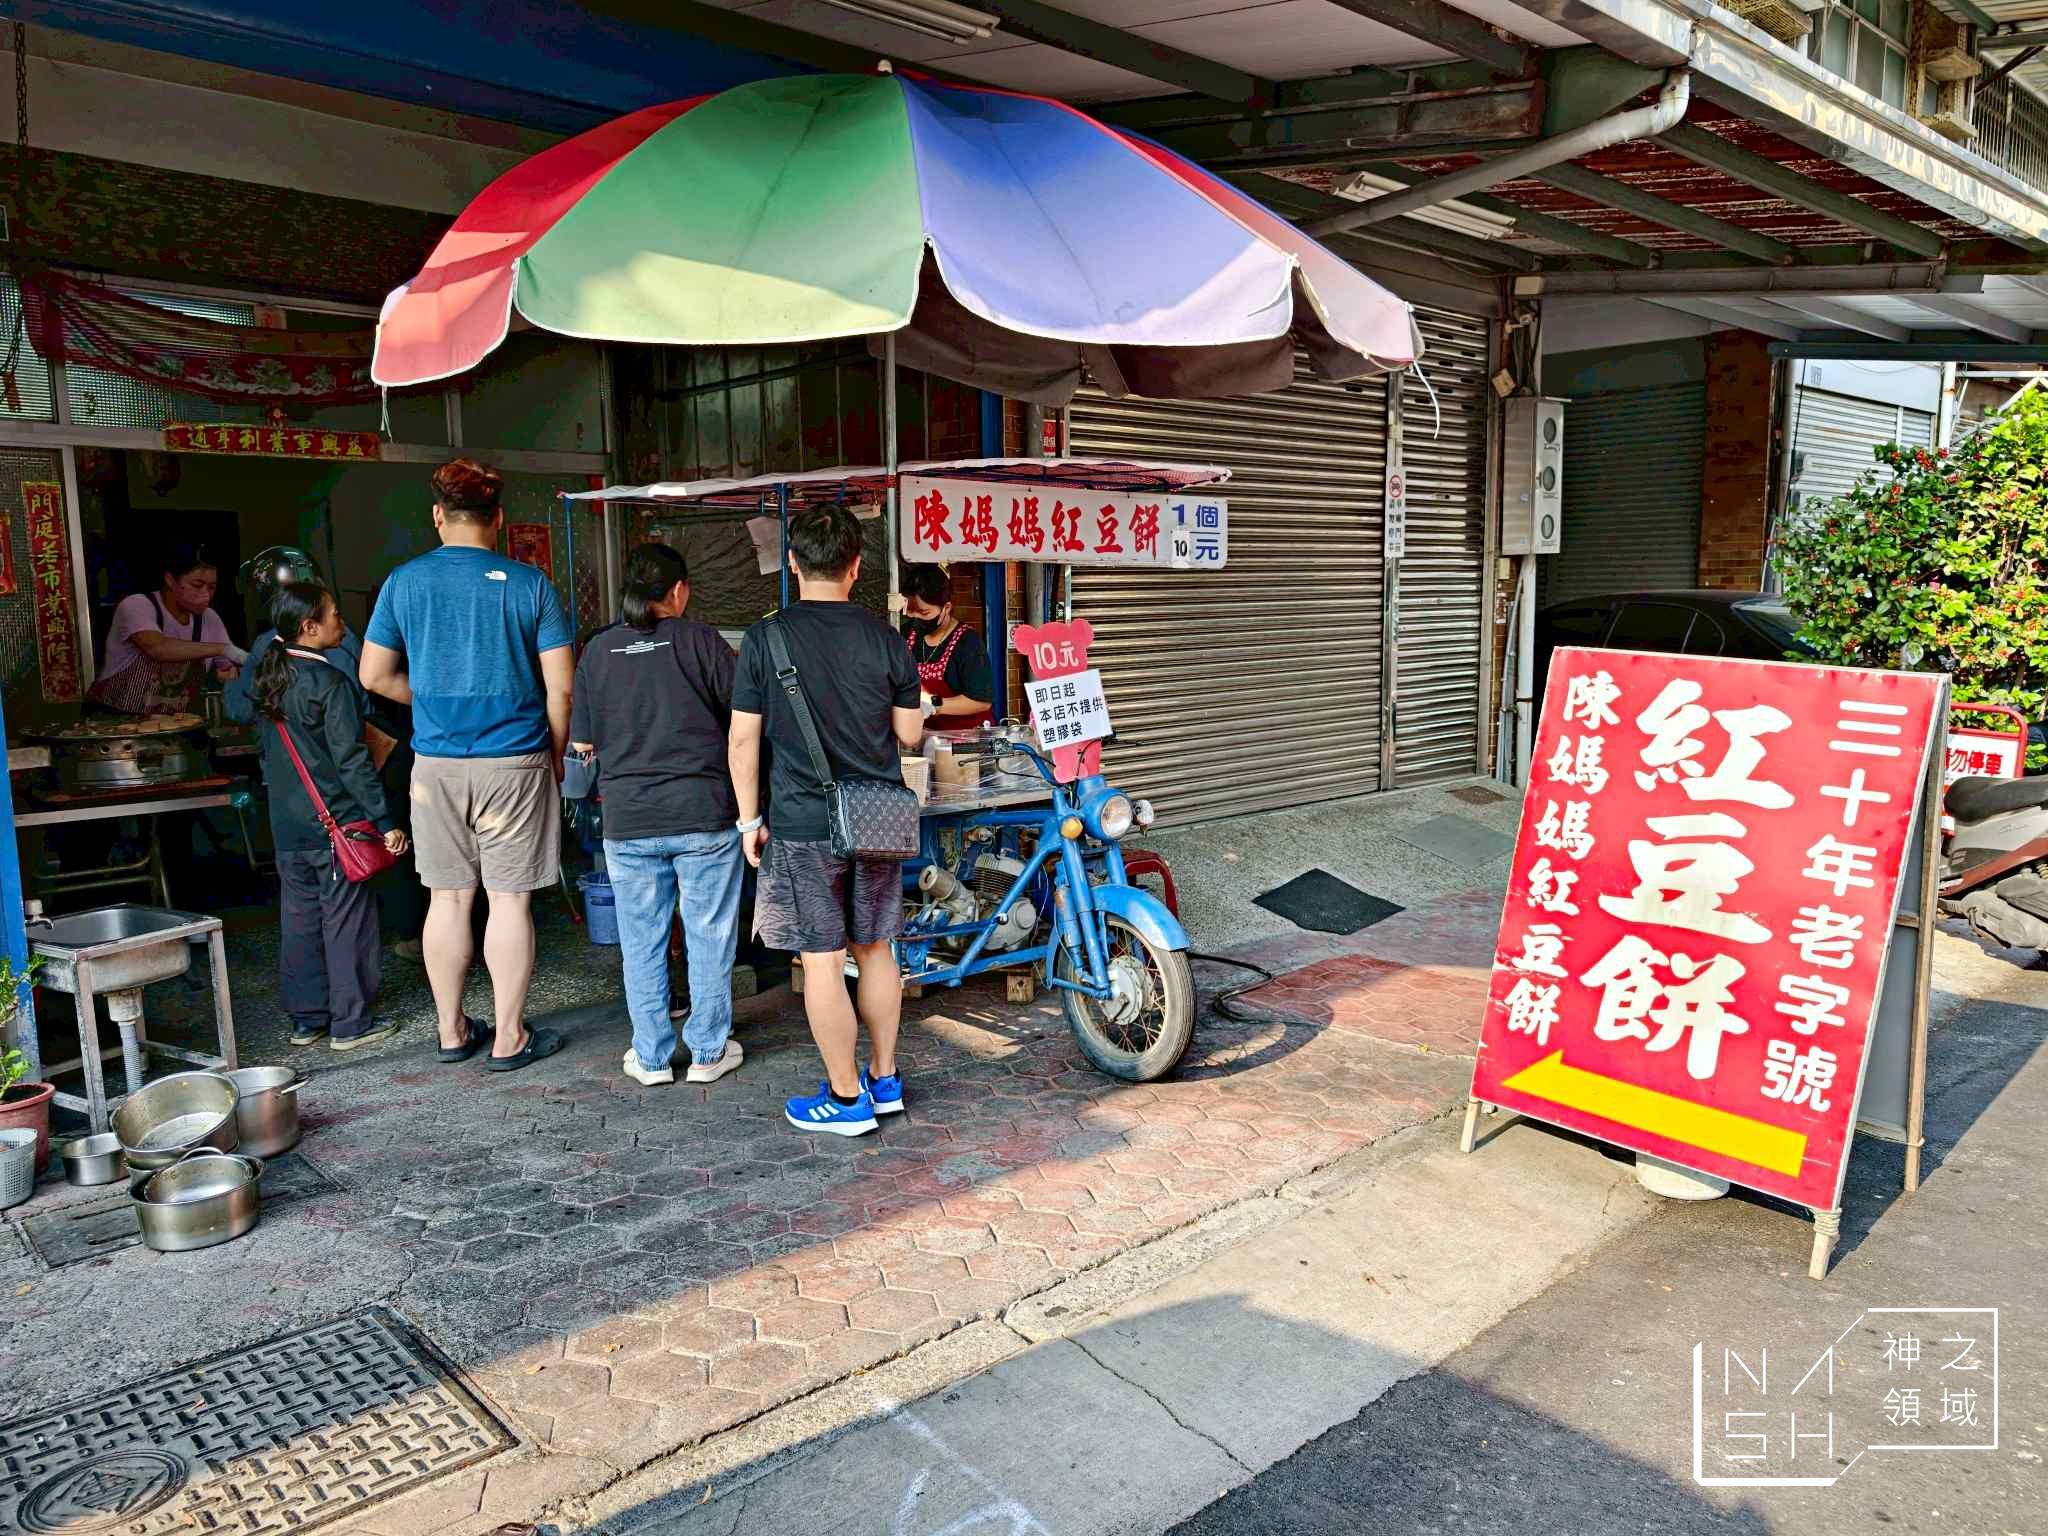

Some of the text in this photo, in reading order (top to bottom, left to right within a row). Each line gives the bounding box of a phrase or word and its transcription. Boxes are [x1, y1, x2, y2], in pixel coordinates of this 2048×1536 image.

[914, 489, 1160, 560] 陳媽媽紅豆餅
[1033, 640, 1079, 670] 10元
[1035, 682, 1076, 704] 即日起
[1040, 696, 1104, 723] 本店不提供
[1043, 722, 1083, 744] 塑膠袋
[1505, 671, 1622, 1046] 陳媽媽紅豆餅
[1580, 678, 1795, 1080] 紅豆餅
[1760, 699, 1908, 1112] 三十年老字號
